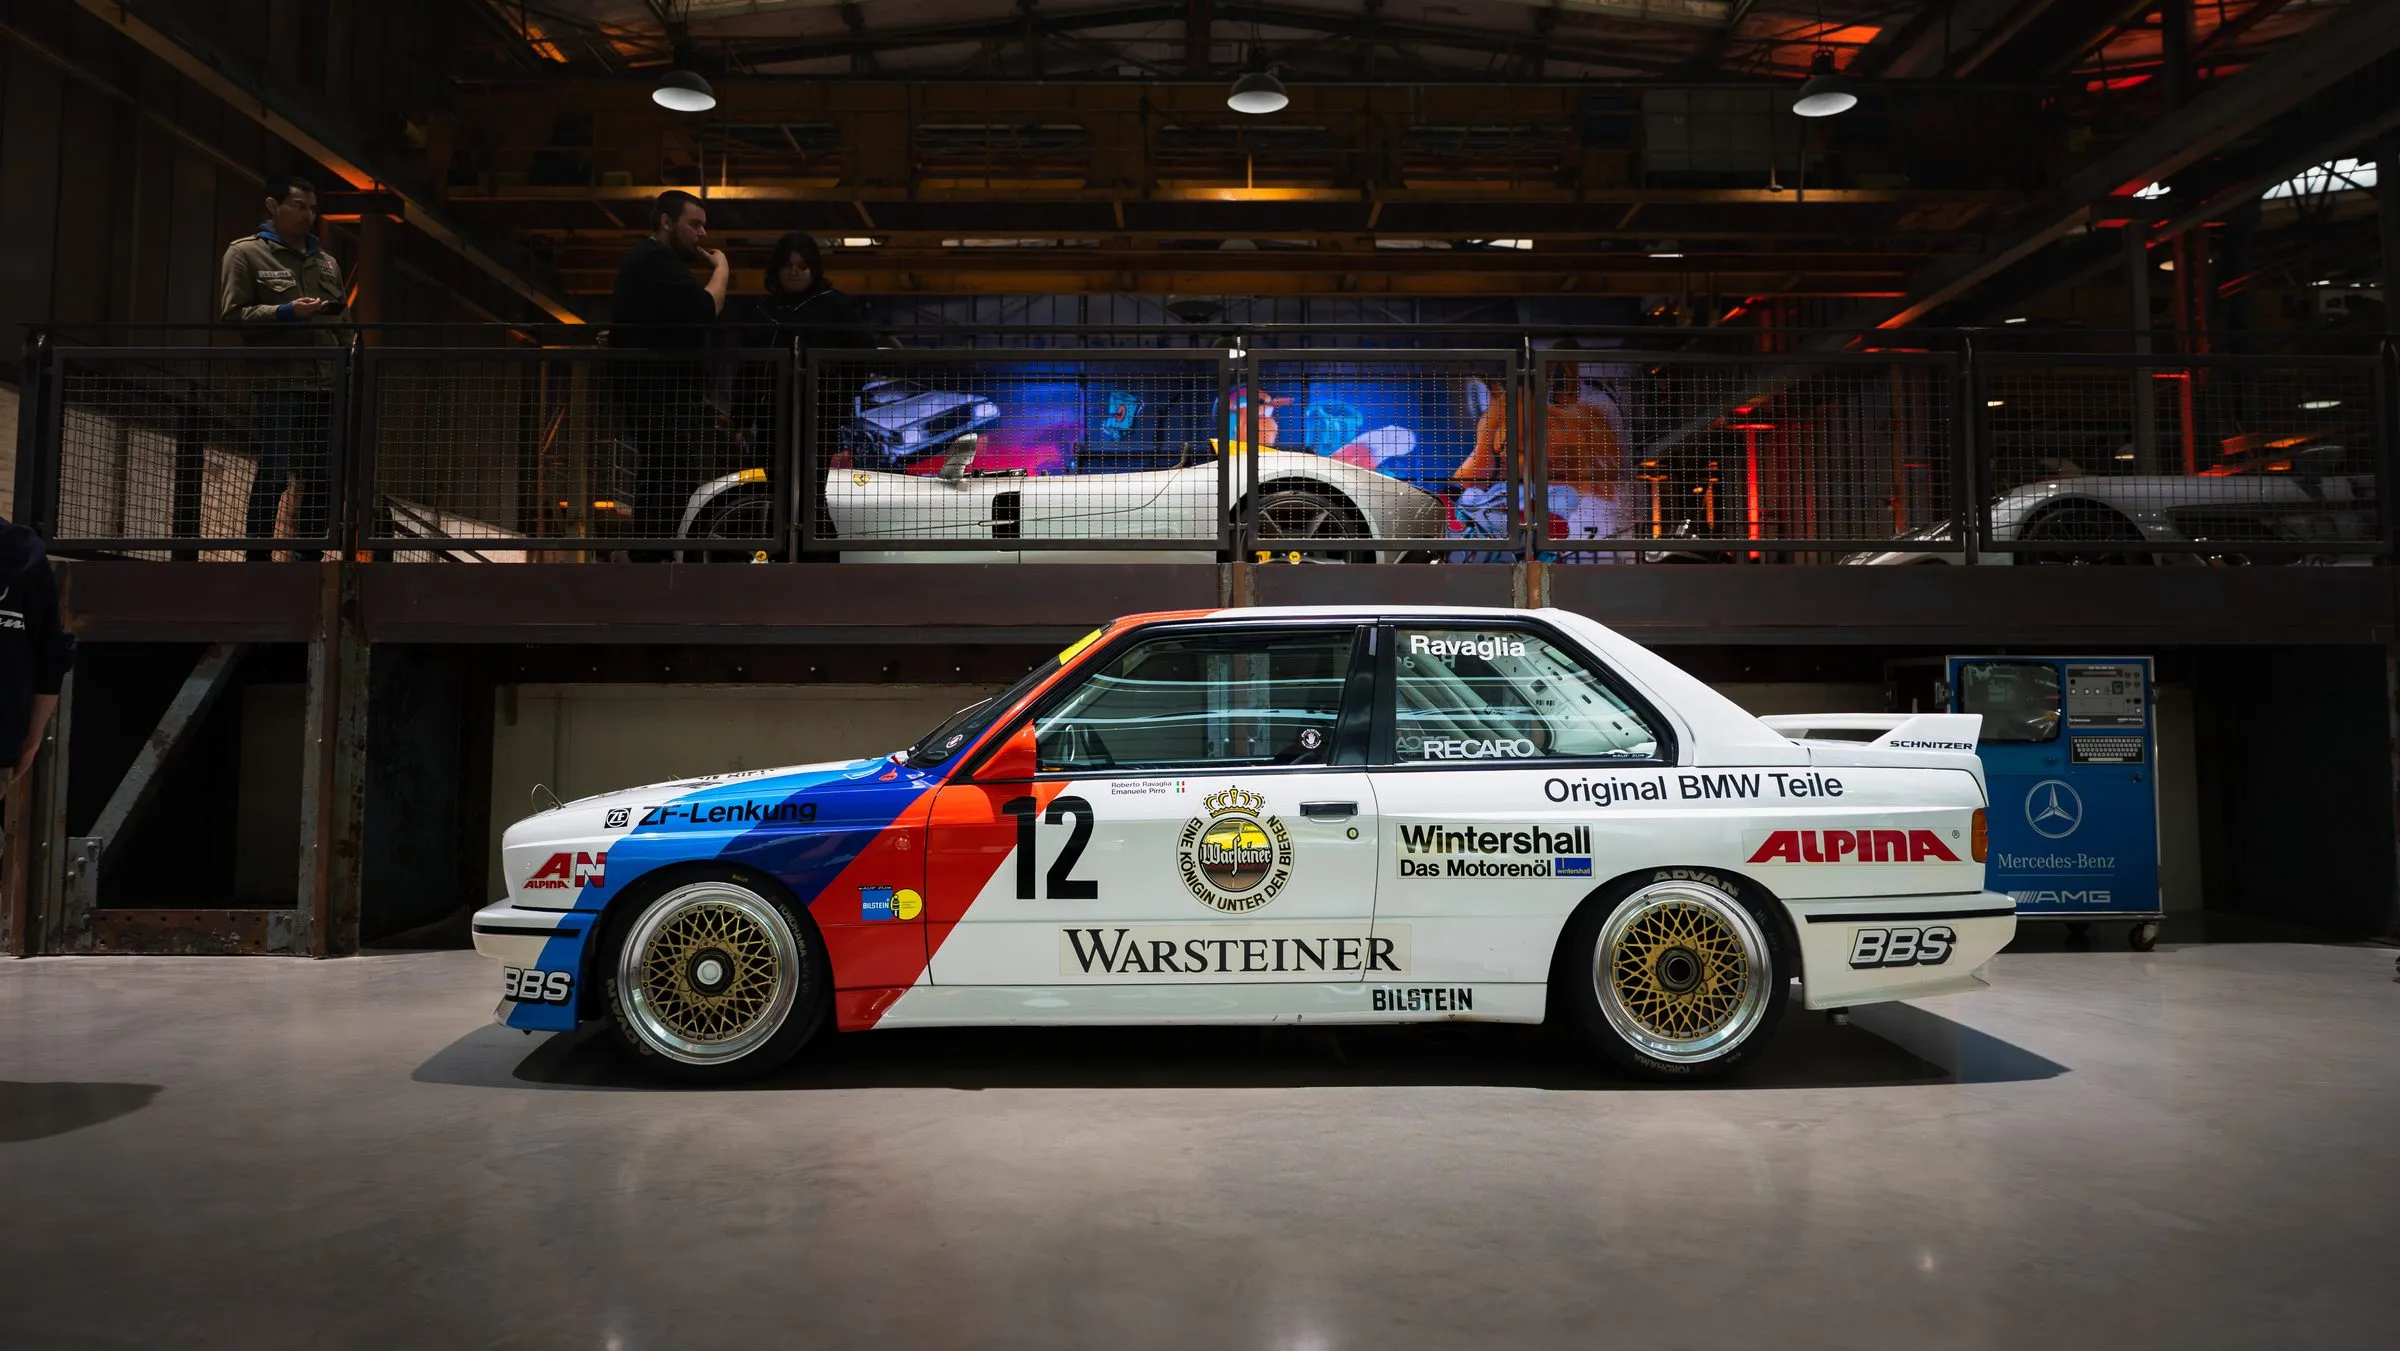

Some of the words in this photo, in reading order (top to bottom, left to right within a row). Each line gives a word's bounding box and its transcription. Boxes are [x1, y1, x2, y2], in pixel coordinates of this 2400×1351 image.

[1410, 634, 1526, 661] Ravaglia
[1424, 738, 1535, 760] RECARO
[1890, 740, 1973, 750] SCHNITZER
[1544, 775, 1668, 807] Original
[1678, 773, 1760, 800] BMW
[1768, 772, 1844, 798] Teile
[606, 809, 630, 826] ZF
[639, 800, 818, 827] ZF-Lenkung
[1181, 816, 1204, 849] EINE
[1266, 815, 1292, 866] BIEREN
[1400, 825, 1591, 854] Wintershall
[1745, 829, 1963, 864] ALPINA
[1001, 795, 1099, 900] 12
[1998, 853, 2115, 868] Mercedes-Benz
[1180, 852, 1216, 905] KÖNIGIN
[1400, 859, 1440, 877] Das
[1447, 859, 1552, 877] Motorenöl
[1557, 867, 1591, 875] wintershall
[523, 880, 569, 889] ALPINA
[1264, 869, 1288, 898] DEN
[1653, 869, 1740, 897] ADVAN
[2035, 890, 2111, 904] AMG
[1217, 892, 1266, 911] UNTER
[778, 903, 807, 958] YOKOHAMA
[1063, 928, 1402, 974] WARSTEINER
[1849, 926, 1955, 968] BBS
[504, 966, 573, 1004] BBS
[1372, 988, 1473, 1012] BILSTEIN
